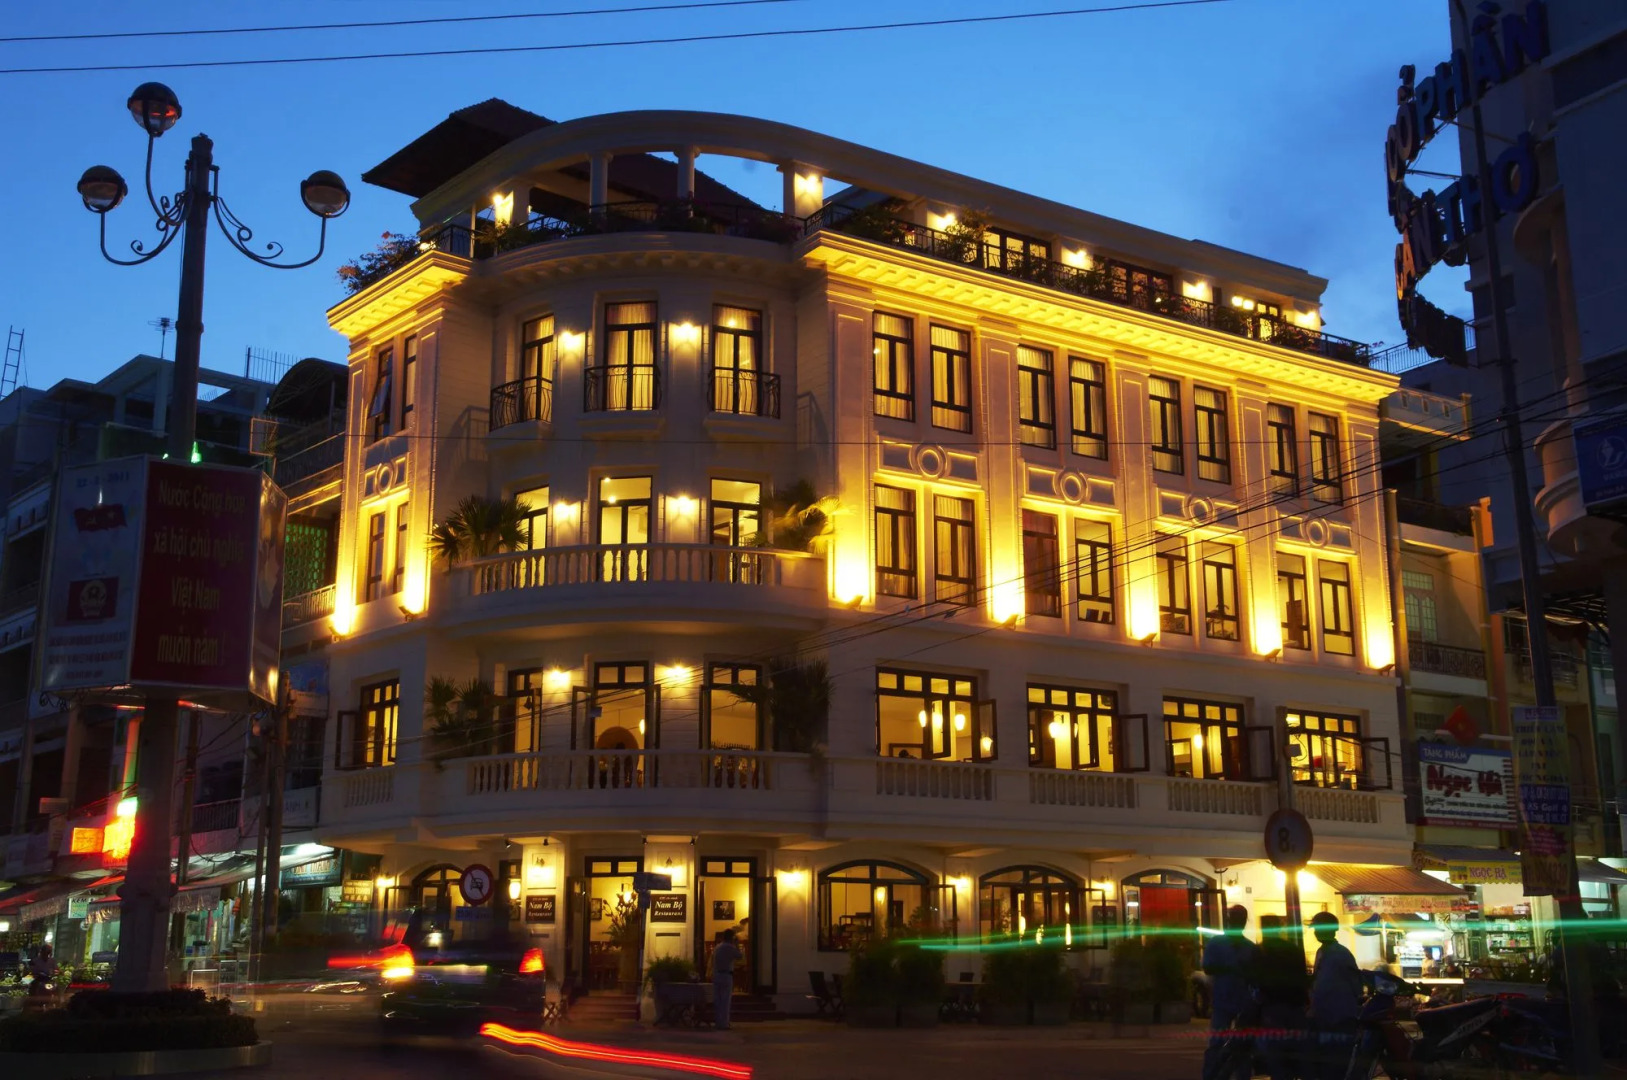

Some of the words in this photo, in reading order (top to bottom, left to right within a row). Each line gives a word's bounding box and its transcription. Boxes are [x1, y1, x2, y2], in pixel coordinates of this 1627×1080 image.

[193, 484, 224, 517] Cộng
[171, 576, 193, 616] Việt
[194, 578, 221, 611] Nam
[655, 901, 672, 909] Nam
